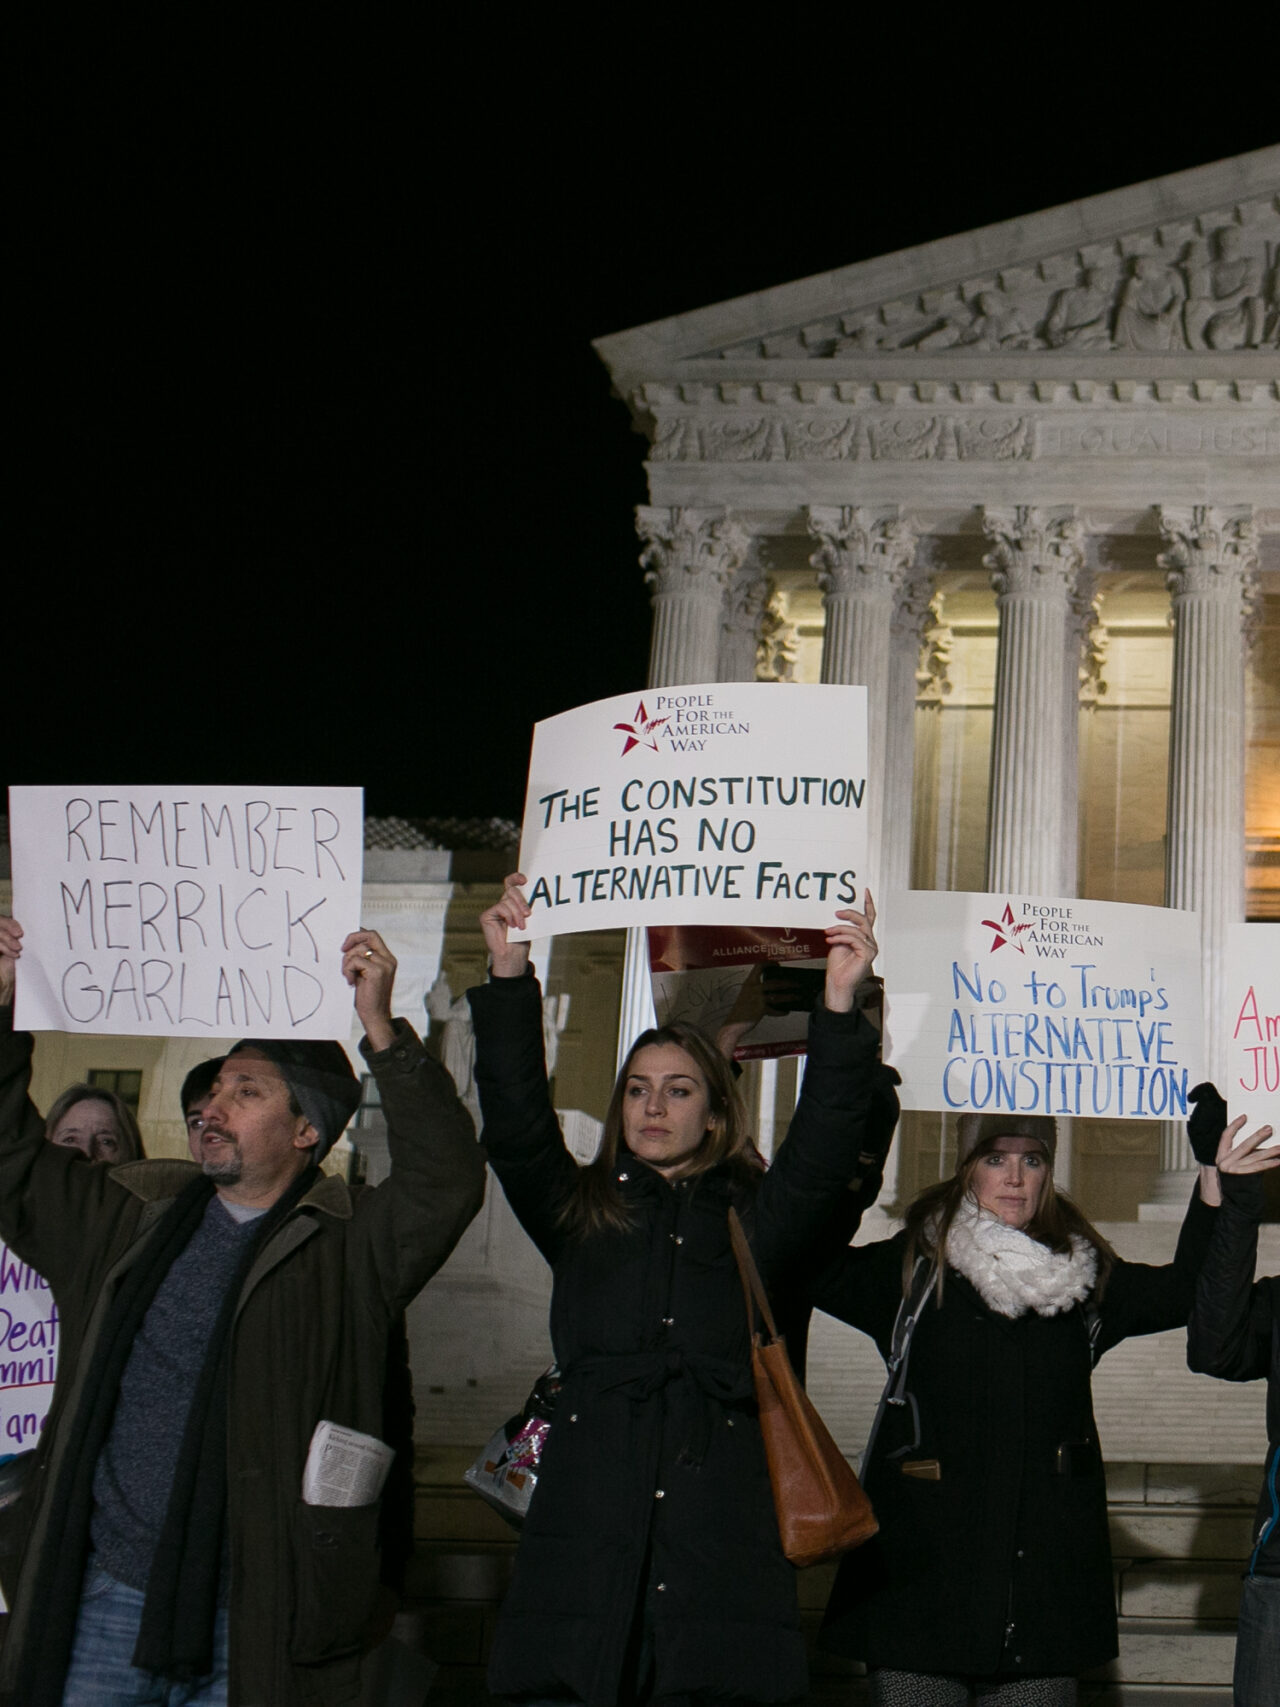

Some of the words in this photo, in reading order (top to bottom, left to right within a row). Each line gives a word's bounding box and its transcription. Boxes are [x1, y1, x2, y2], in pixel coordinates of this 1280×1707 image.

[656, 694, 714, 710] PEOPLE
[675, 709, 710, 723] FOR
[712, 711, 735, 720] THE
[661, 722, 750, 738] AMERICAN
[670, 739, 708, 752] WAY
[539, 786, 601, 828] THE
[621, 775, 866, 812] CONSTITUTION
[66, 798, 345, 881] REMEMBER
[609, 817, 679, 857] HAS
[698, 817, 756, 853] NO
[526, 864, 745, 908] ALTERNATIVE
[756, 862, 857, 904] FACTS
[60, 878, 328, 963] MERRICK
[1022, 902, 1073, 919] PEOPLE
[1027, 931, 1104, 947] AMERICAN
[1040, 918, 1070, 933] FOR
[1072, 923, 1091, 933] THE
[712, 945, 767, 957] ALLIANCE
[1035, 945, 1068, 959] WAY
[61, 959, 324, 1027] GARLAND
[952, 961, 1007, 1003] No
[1024, 970, 1066, 1008] to
[1070, 964, 1169, 1018] Trump's
[947, 1008, 1179, 1065] ALTERNATIVE
[943, 1057, 1189, 1116] CONSTITUTION
